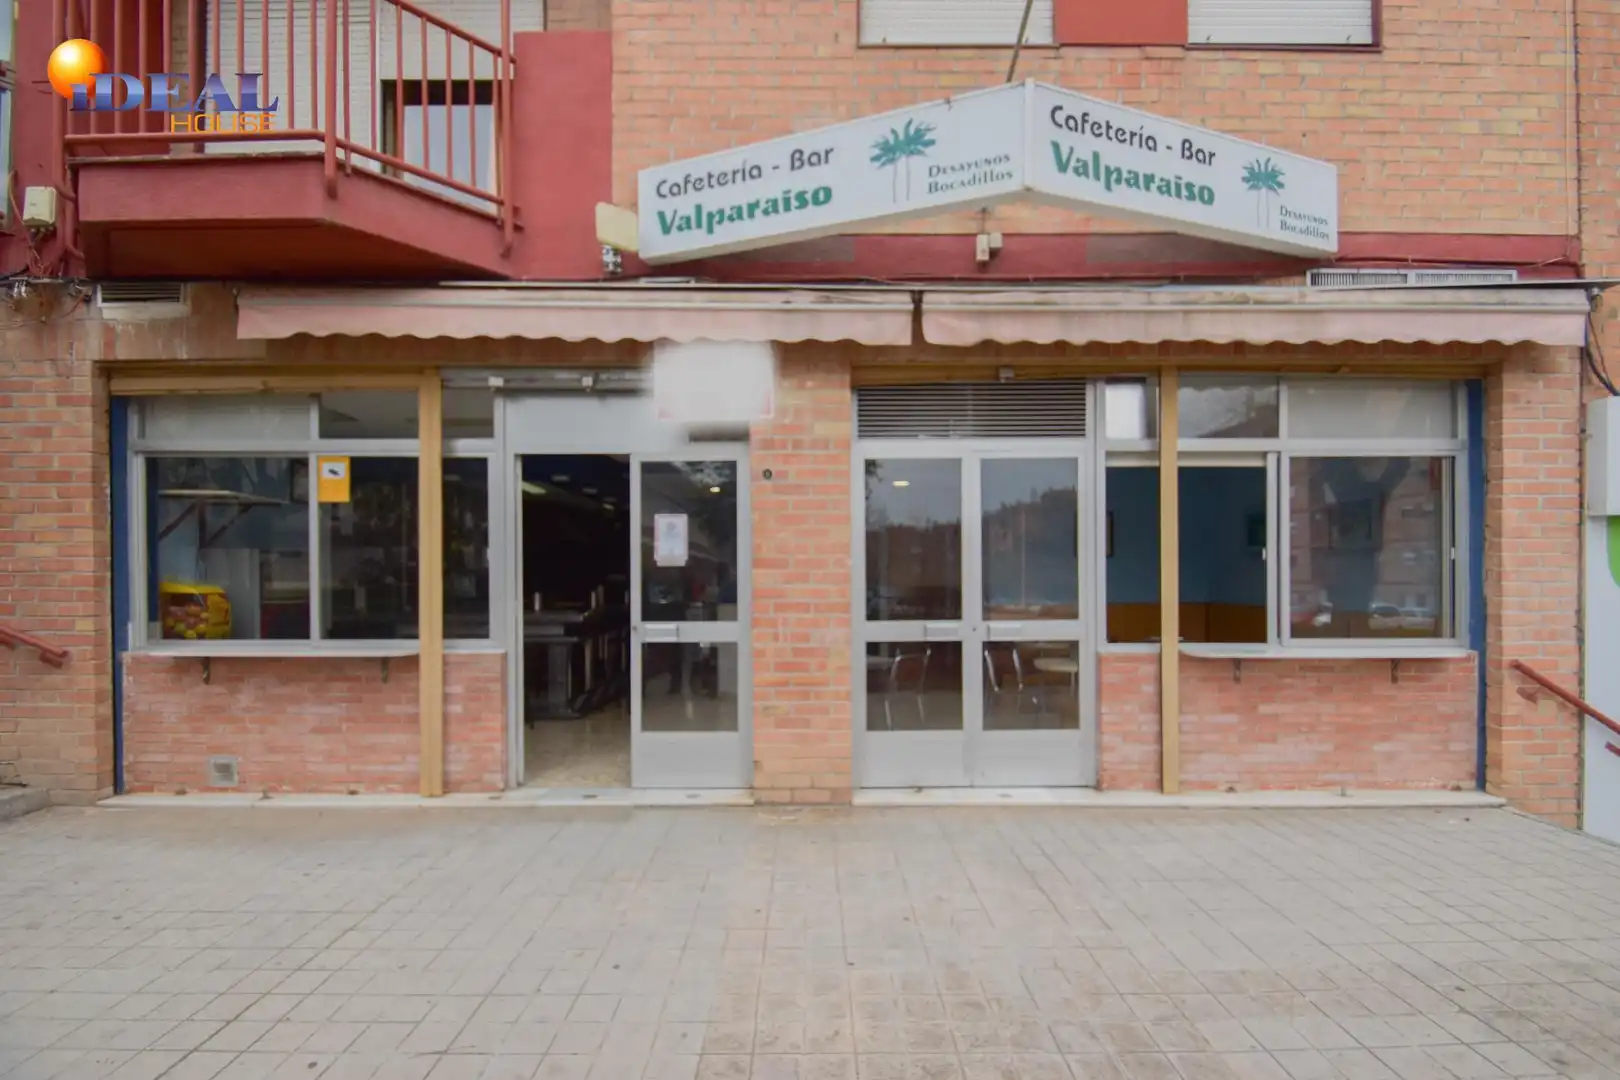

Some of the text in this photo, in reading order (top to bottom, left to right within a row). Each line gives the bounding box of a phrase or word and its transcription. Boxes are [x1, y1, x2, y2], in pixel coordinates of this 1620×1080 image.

[1050, 104, 1158, 152] Cafetería
[1180, 137, 1217, 167] Bar
[656, 158, 763, 199] Cafetería
[789, 147, 835, 172] Bar
